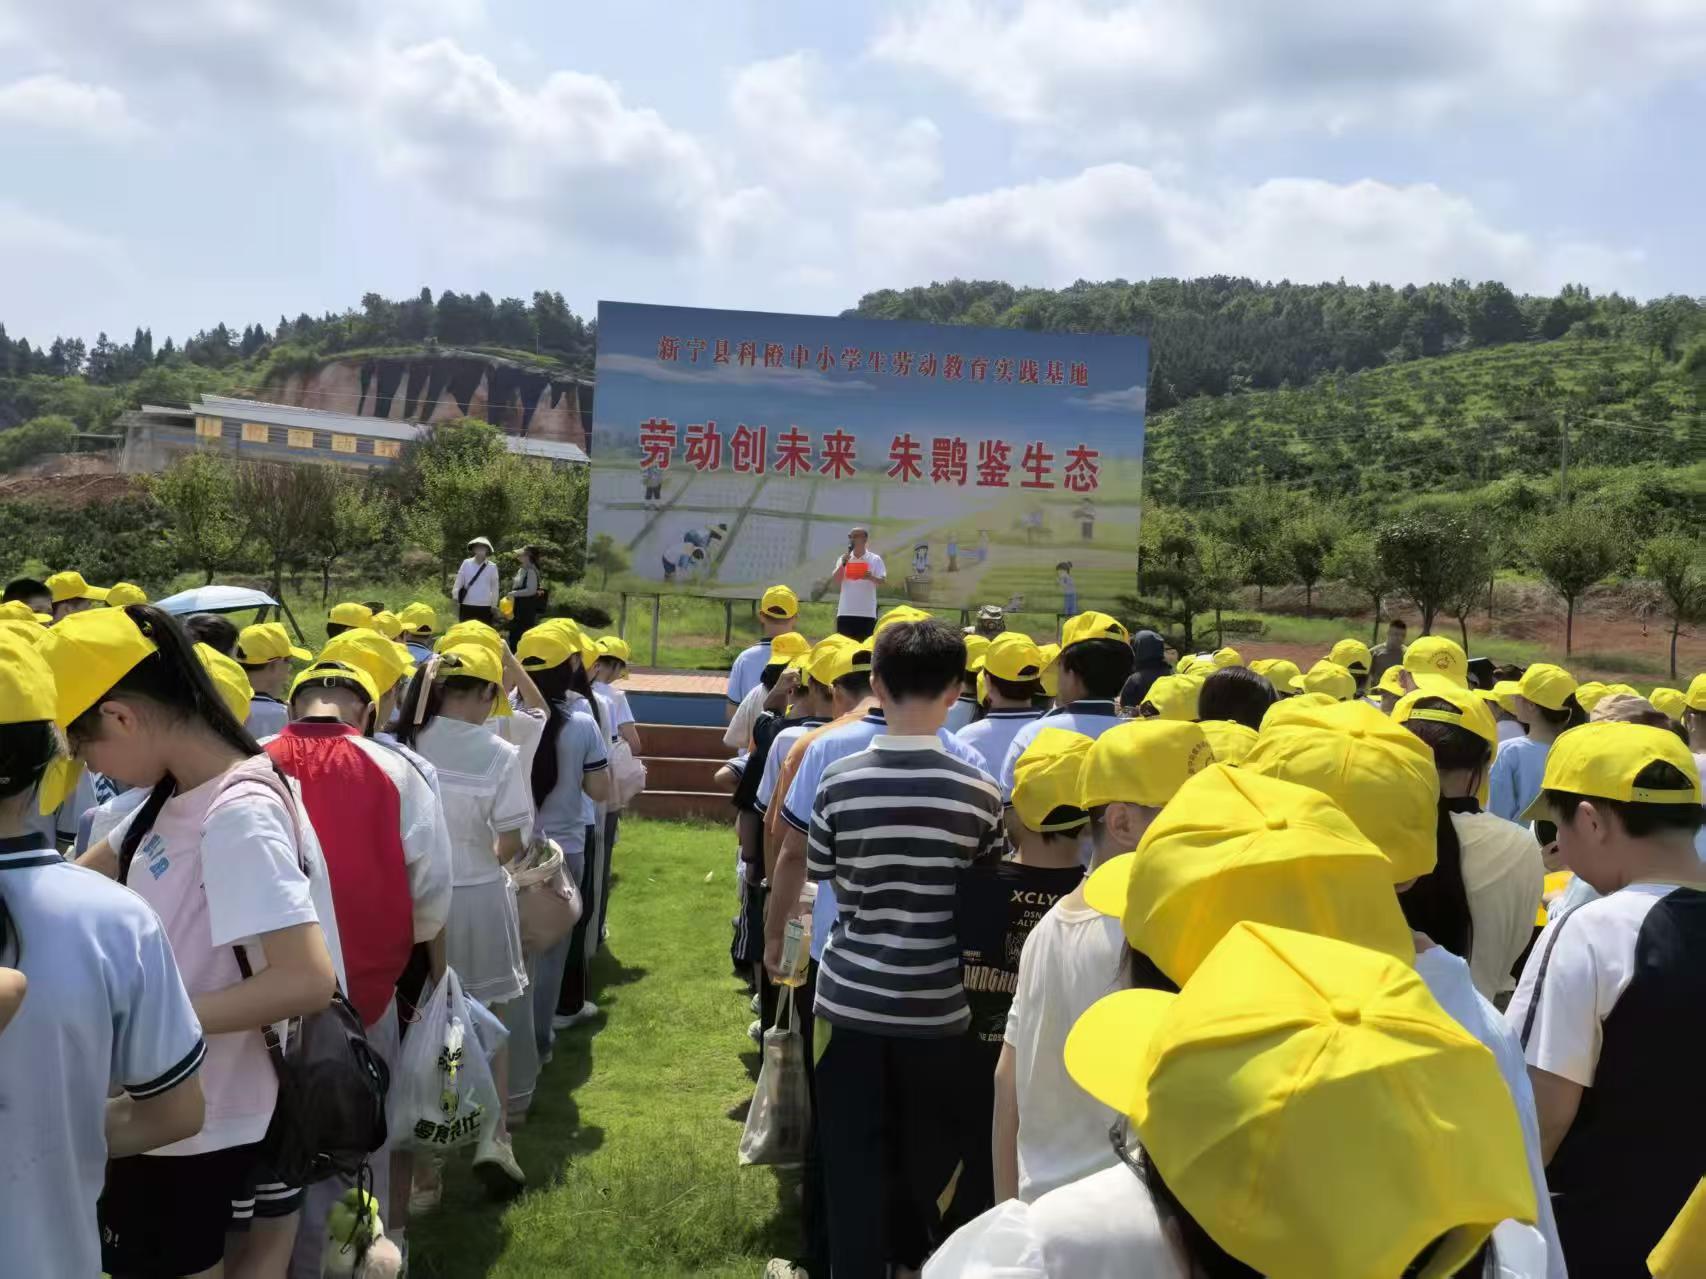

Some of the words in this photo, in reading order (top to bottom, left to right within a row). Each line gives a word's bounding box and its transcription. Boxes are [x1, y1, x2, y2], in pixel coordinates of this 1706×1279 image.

[639, 417, 857, 480] 劳动创未来
[887, 433, 1099, 492] 朱鹮鉴生态
